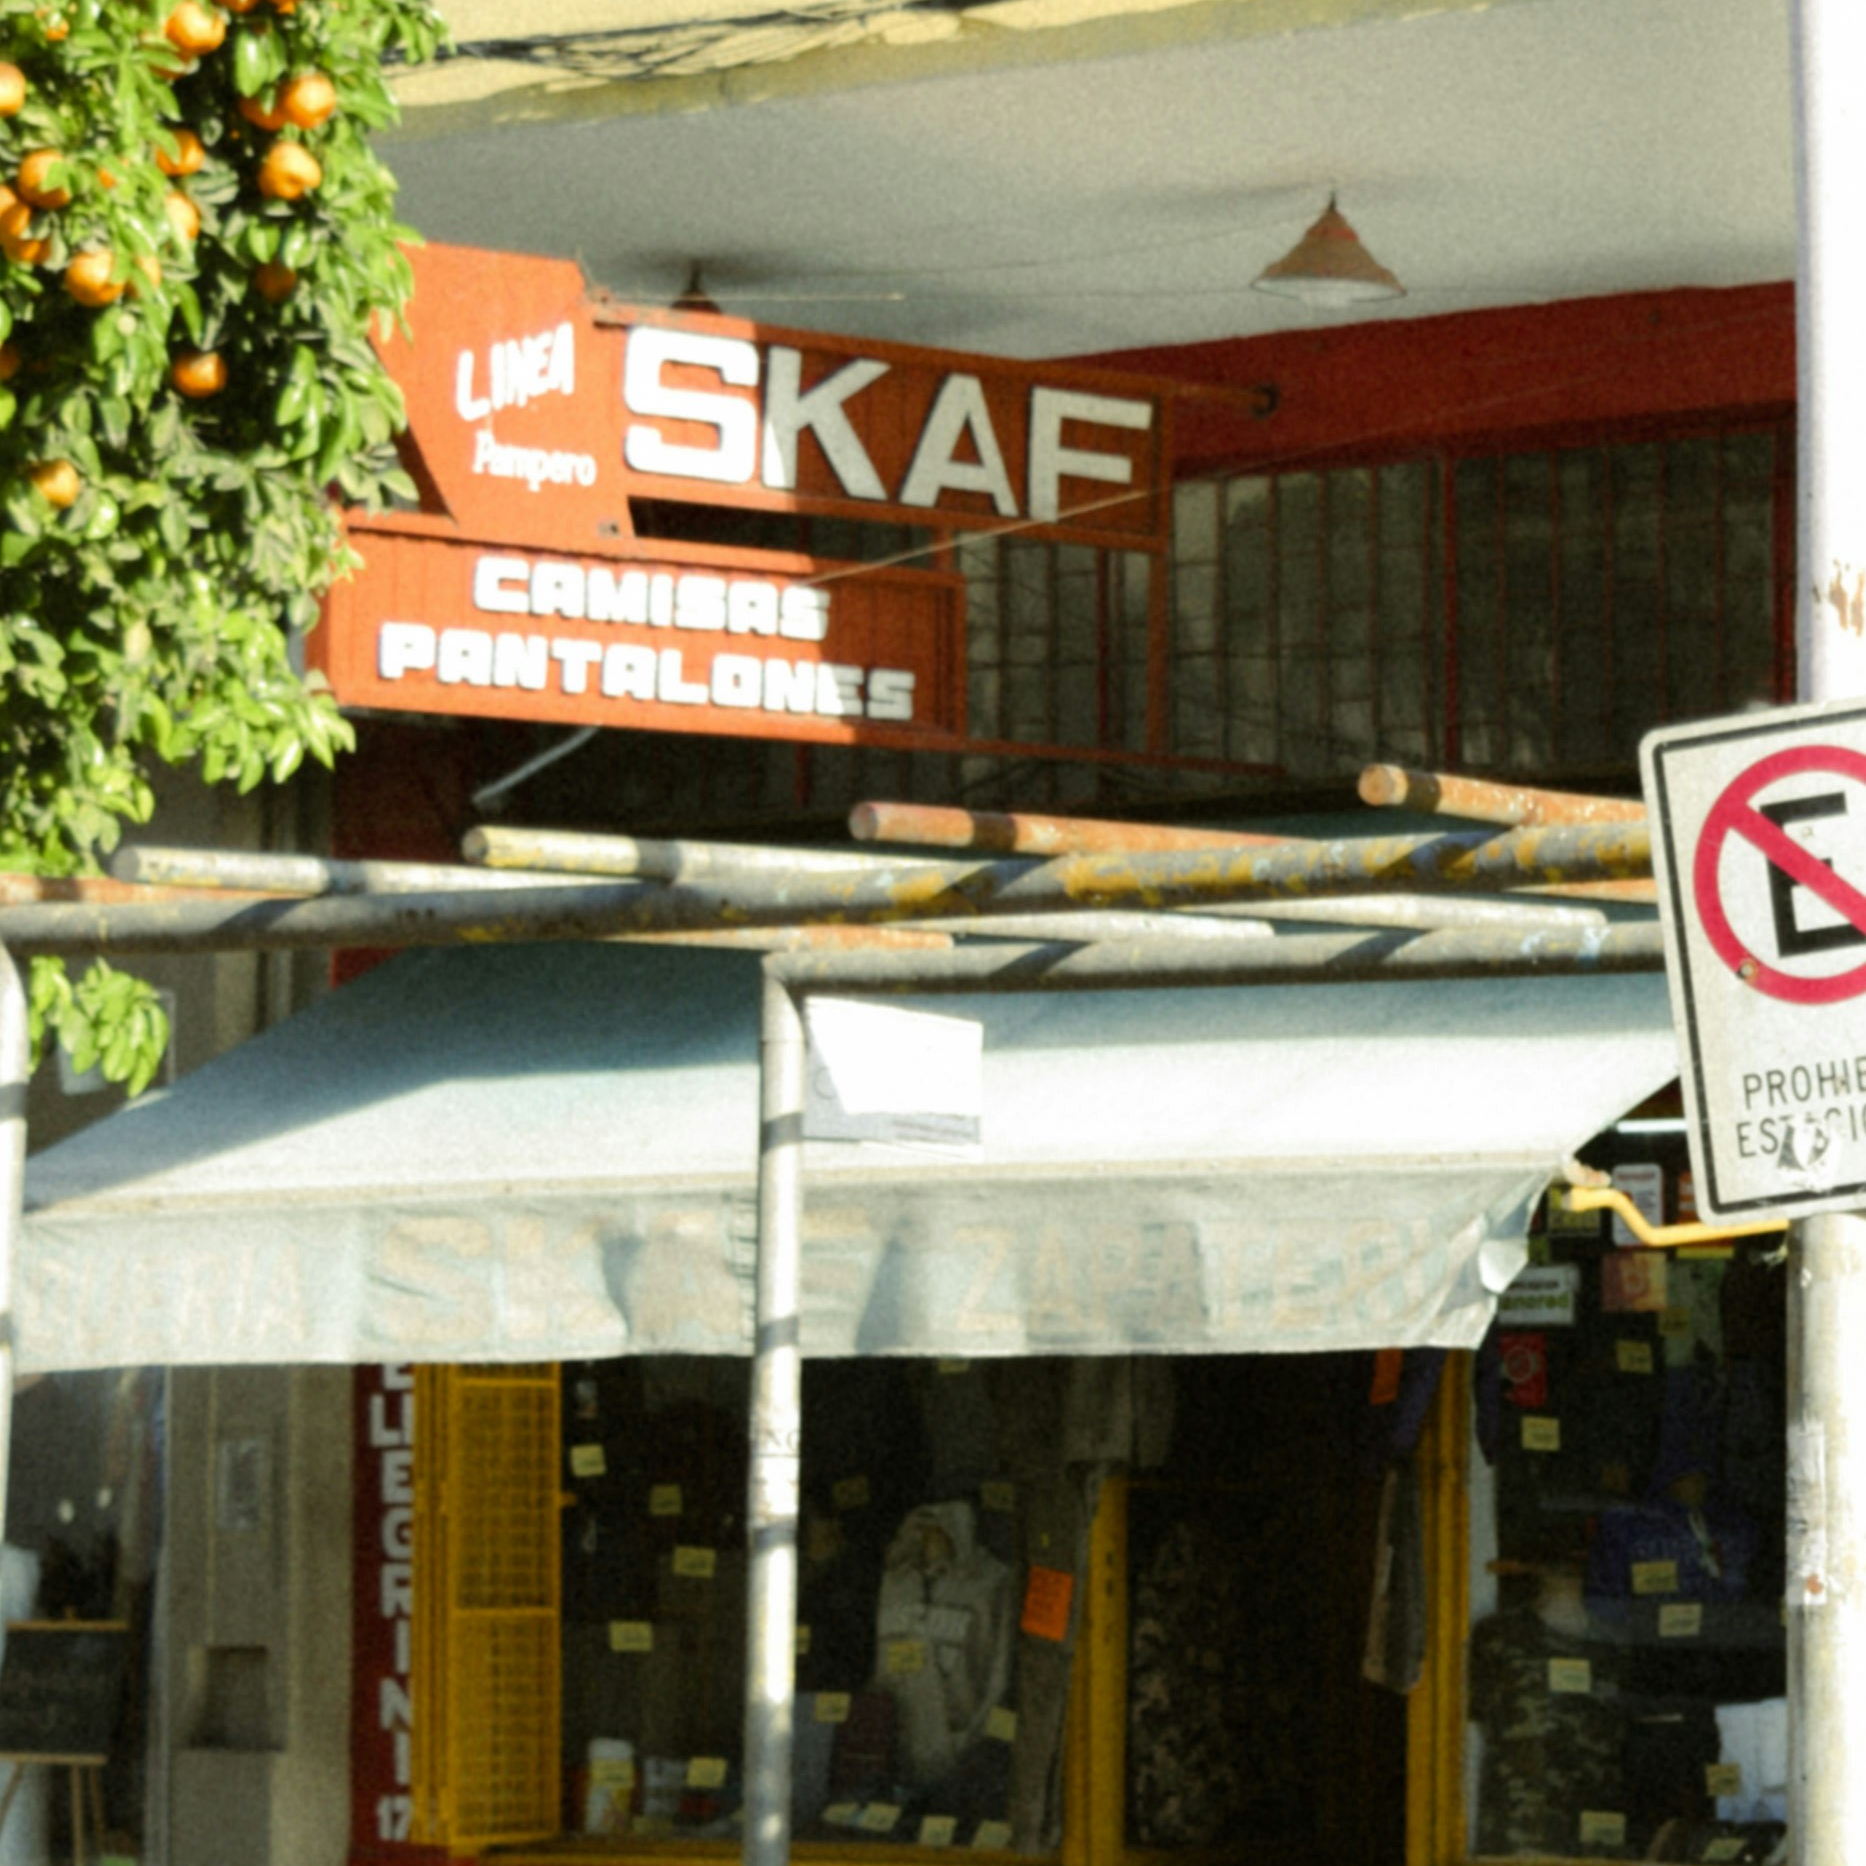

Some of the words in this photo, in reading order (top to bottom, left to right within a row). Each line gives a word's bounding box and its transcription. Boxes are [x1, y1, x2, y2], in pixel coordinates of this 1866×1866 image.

[472, 429, 597, 492] Pampero
[624, 324, 1154, 523] SKAF
[473, 555, 831, 641] CAMISAS
[378, 621, 916, 722] PANTALONES
